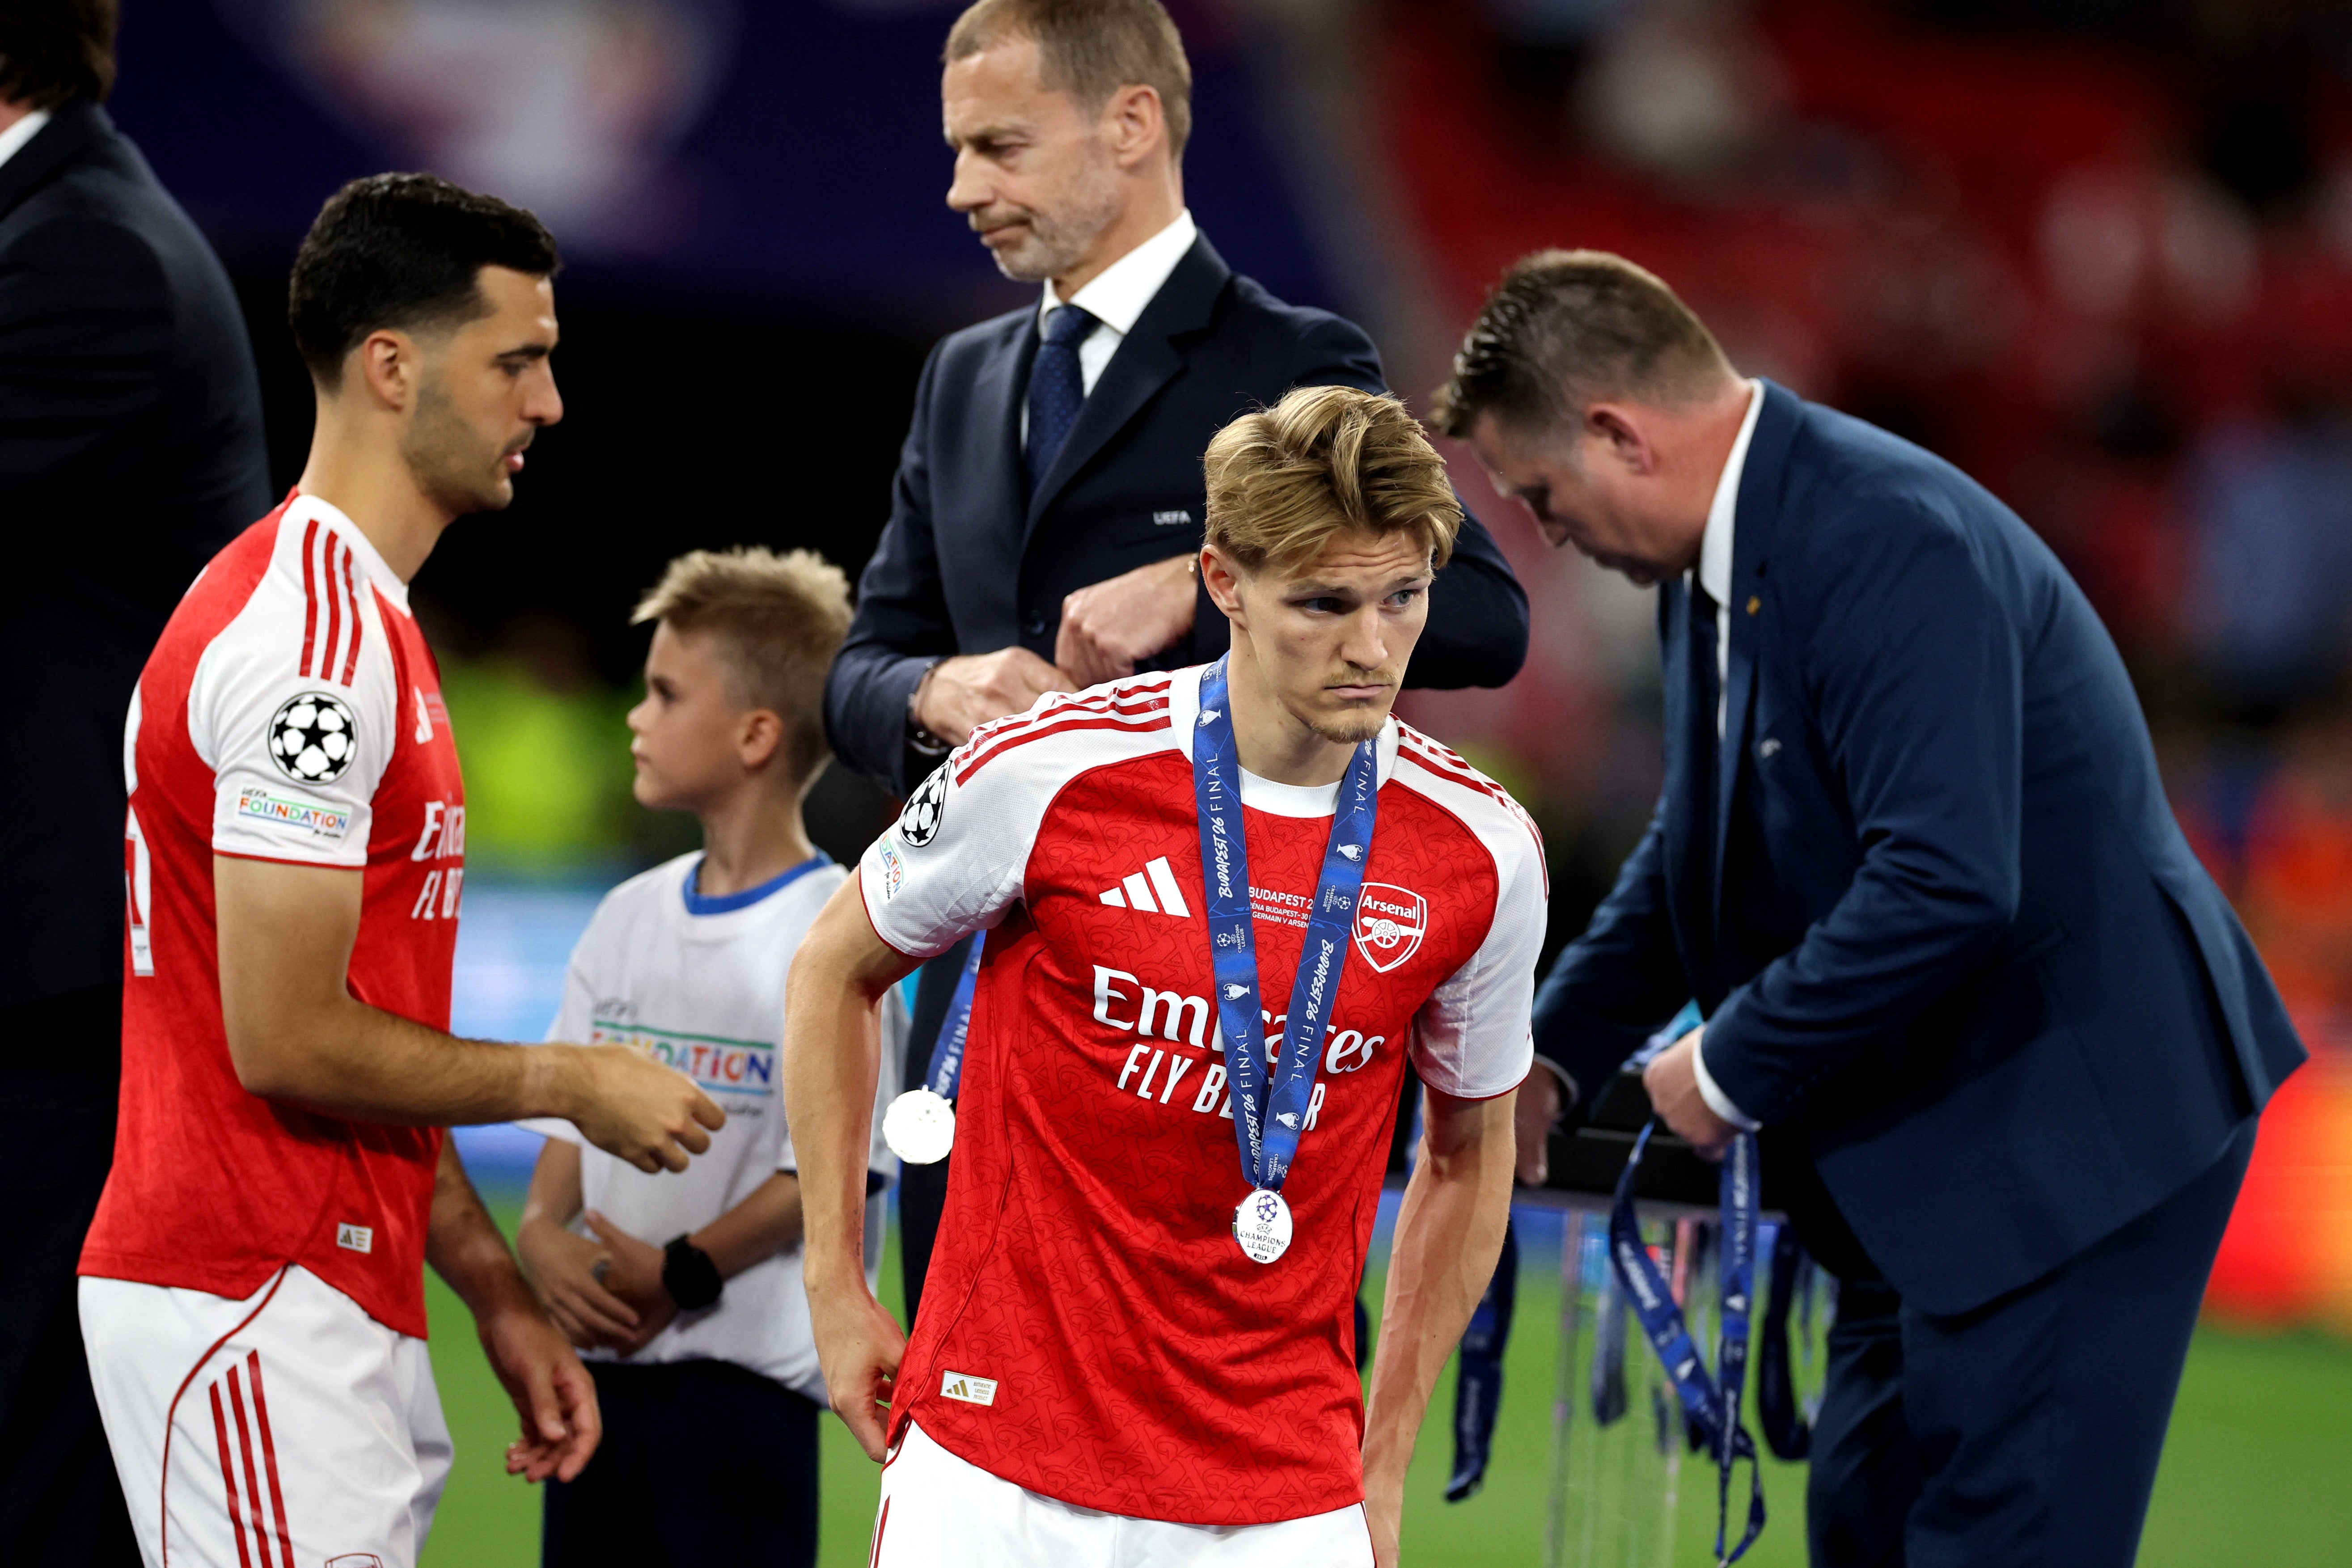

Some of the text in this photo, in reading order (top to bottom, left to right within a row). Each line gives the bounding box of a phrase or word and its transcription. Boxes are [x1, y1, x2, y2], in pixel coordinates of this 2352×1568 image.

[1354, 760, 1371, 814] FINAL
[1206, 753, 1233, 898] BUDAPEST 26 FINAL
[1248, 886, 1307, 908] BUDAPEST
[1250, 900, 1265, 912] ÉNA
[1322, 888, 1331, 908] LEAGUE
[1325, 884, 1336, 913] CHAMPIONS
[1362, 895, 1417, 920] Arsenal
[1252, 911, 1282, 924] GERMAIN
[1287, 920, 1309, 929] ARSEN
[1290, 939, 1333, 1082] BUDAPEST 26 FINAL
[1235, 1029, 1252, 1089] FINAL
[1117, 1043, 1193, 1105] FLY
[1242, 1093, 1256, 1112] 26
[1268, 1153, 1279, 1181] CHAMPIONS
[1239, 1230, 1286, 1247] CHAMPIONS
[1247, 1241, 1278, 1254] LEAGUE
